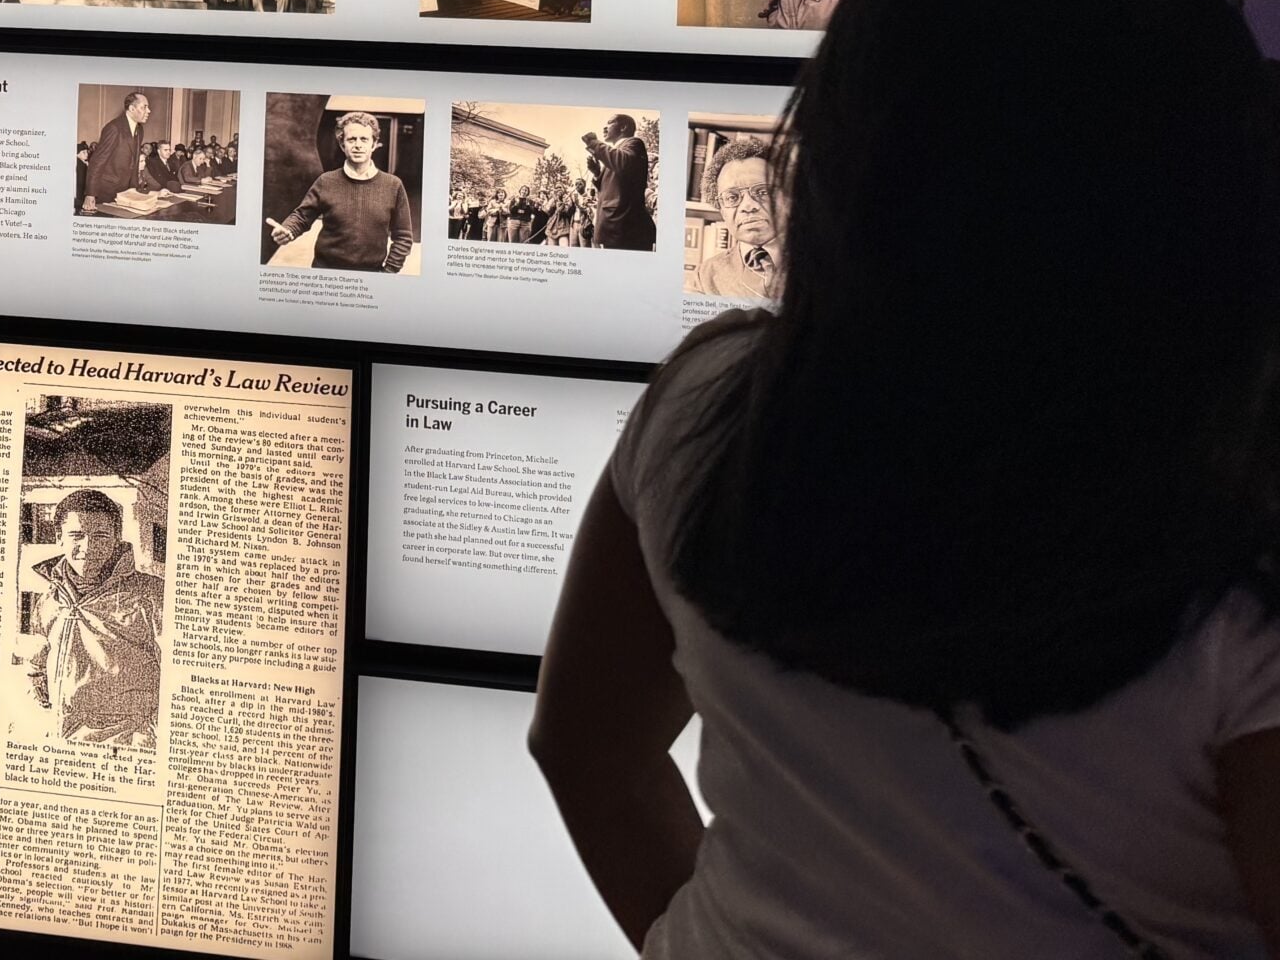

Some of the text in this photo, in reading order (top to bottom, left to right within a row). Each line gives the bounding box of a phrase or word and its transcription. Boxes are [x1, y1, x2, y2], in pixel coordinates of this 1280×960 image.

[46, 360, 65, 375] to
[68, 358, 122, 380] Head
[224, 370, 271, 390] Law
[274, 374, 348, 397] Review
[406, 393, 537, 417] Pursuing a Career
[406, 414, 452, 431] in Law
[404, 445, 424, 453] After
[424, 447, 465, 458] graduating
[465, 449, 484, 458] from
[525, 455, 558, 464] Michelle
[404, 458, 435, 466] enrolled
[445, 460, 475, 470] Harvard
[477, 463, 493, 471] Law
[521, 466, 536, 475] She
[552, 470, 575, 478] active
[190, 674, 219, 685] Blacks
[273, 683, 292, 692] New
[294, 685, 315, 696] High
[4, 771, 28, 783] black
[30, 776, 39, 784] to
[41, 776, 61, 787] hold
[63, 779, 77, 788] the
